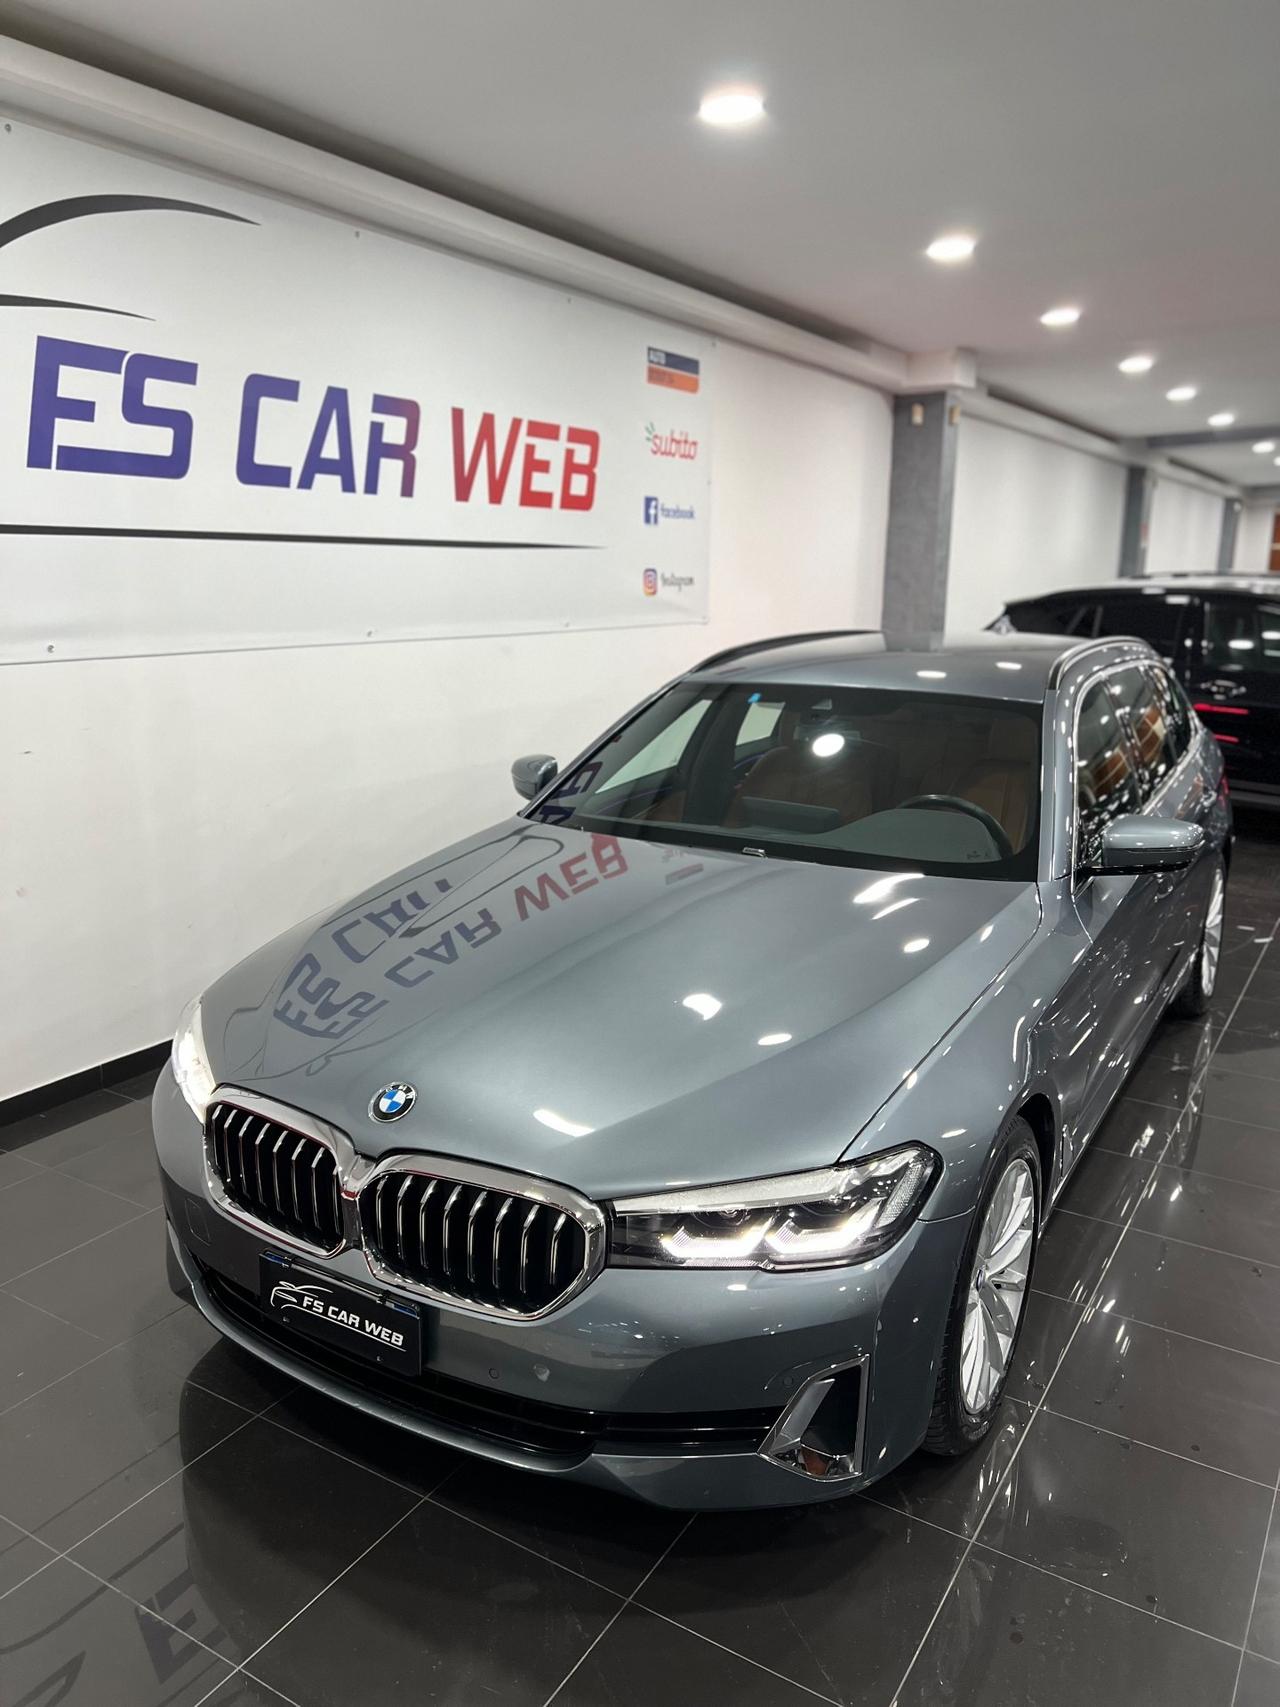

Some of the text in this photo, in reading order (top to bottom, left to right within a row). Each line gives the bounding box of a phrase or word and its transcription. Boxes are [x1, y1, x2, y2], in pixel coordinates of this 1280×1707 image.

[236, 373, 420, 498] CAR
[451, 406, 600, 511] WEB
[651, 429, 698, 460] subito
[302, 1296, 404, 1346] FS CAR WEB
